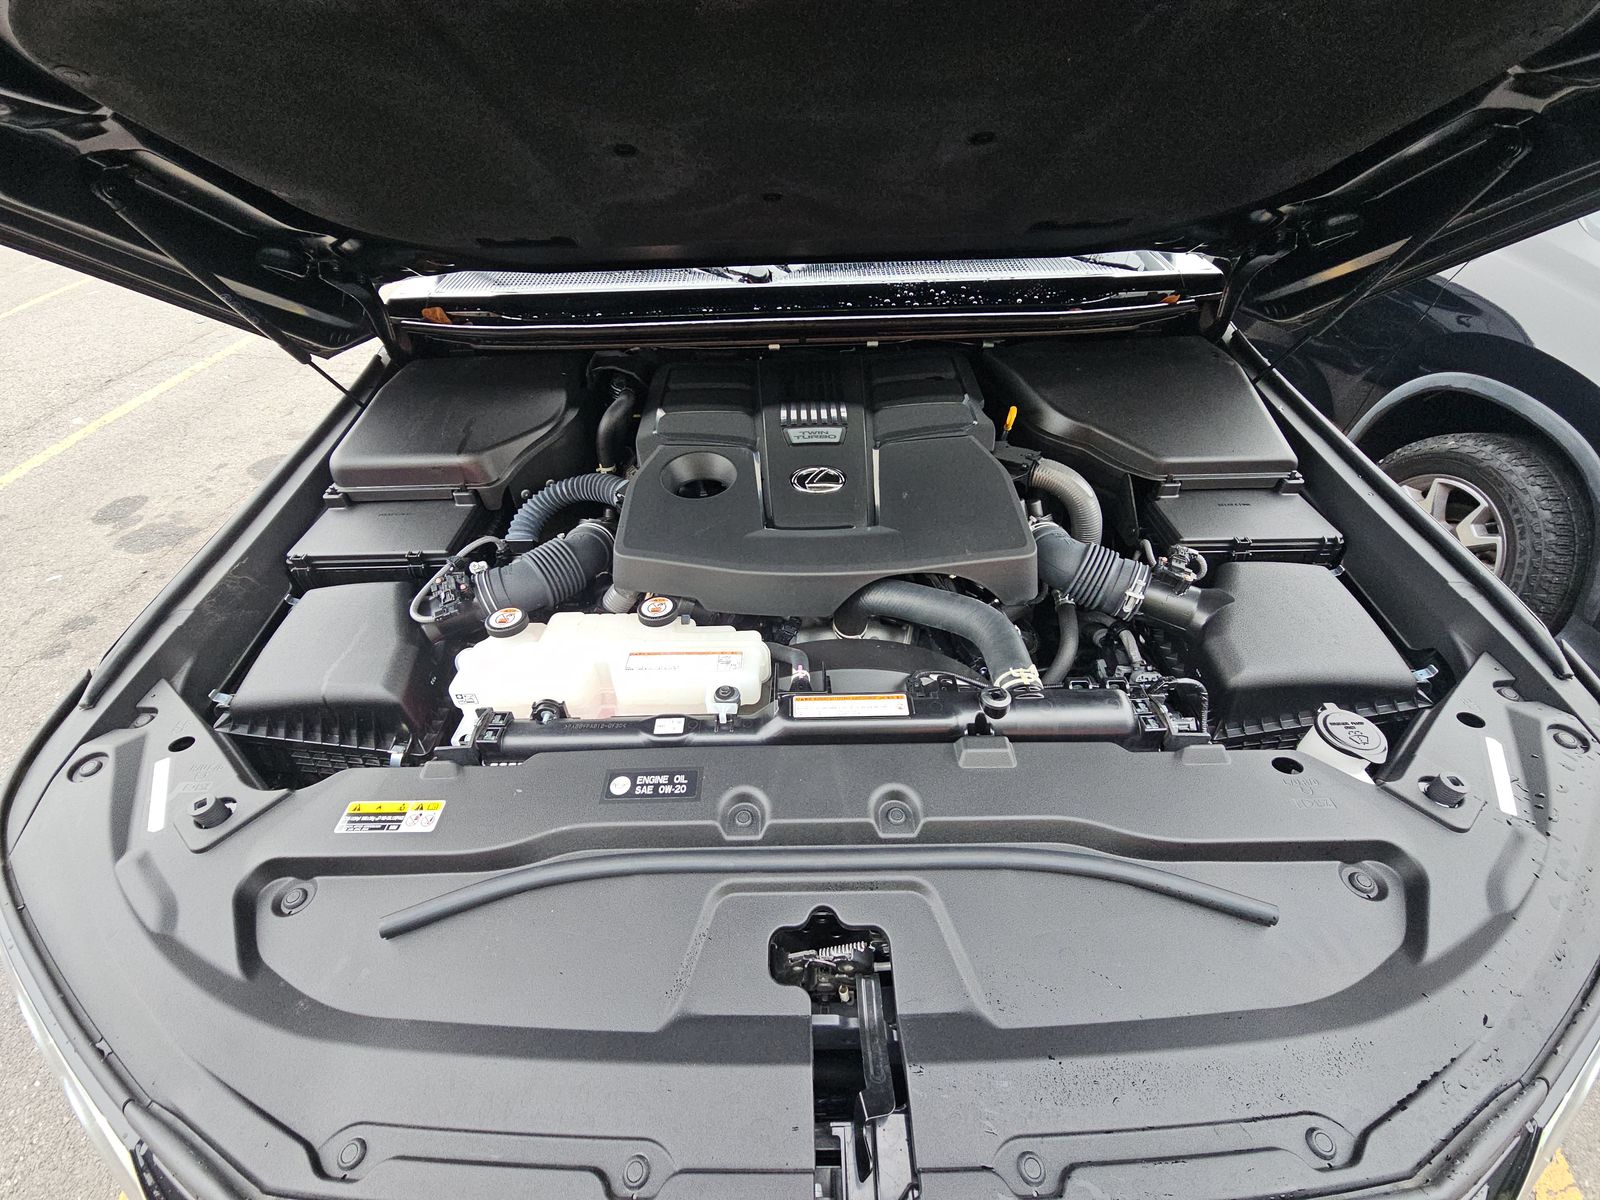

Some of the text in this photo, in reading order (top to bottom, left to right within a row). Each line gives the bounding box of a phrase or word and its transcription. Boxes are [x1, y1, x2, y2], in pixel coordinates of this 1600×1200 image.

[636, 774, 688, 785] ENGINE OIL
[635, 784, 687, 795] SAE 0W-20
